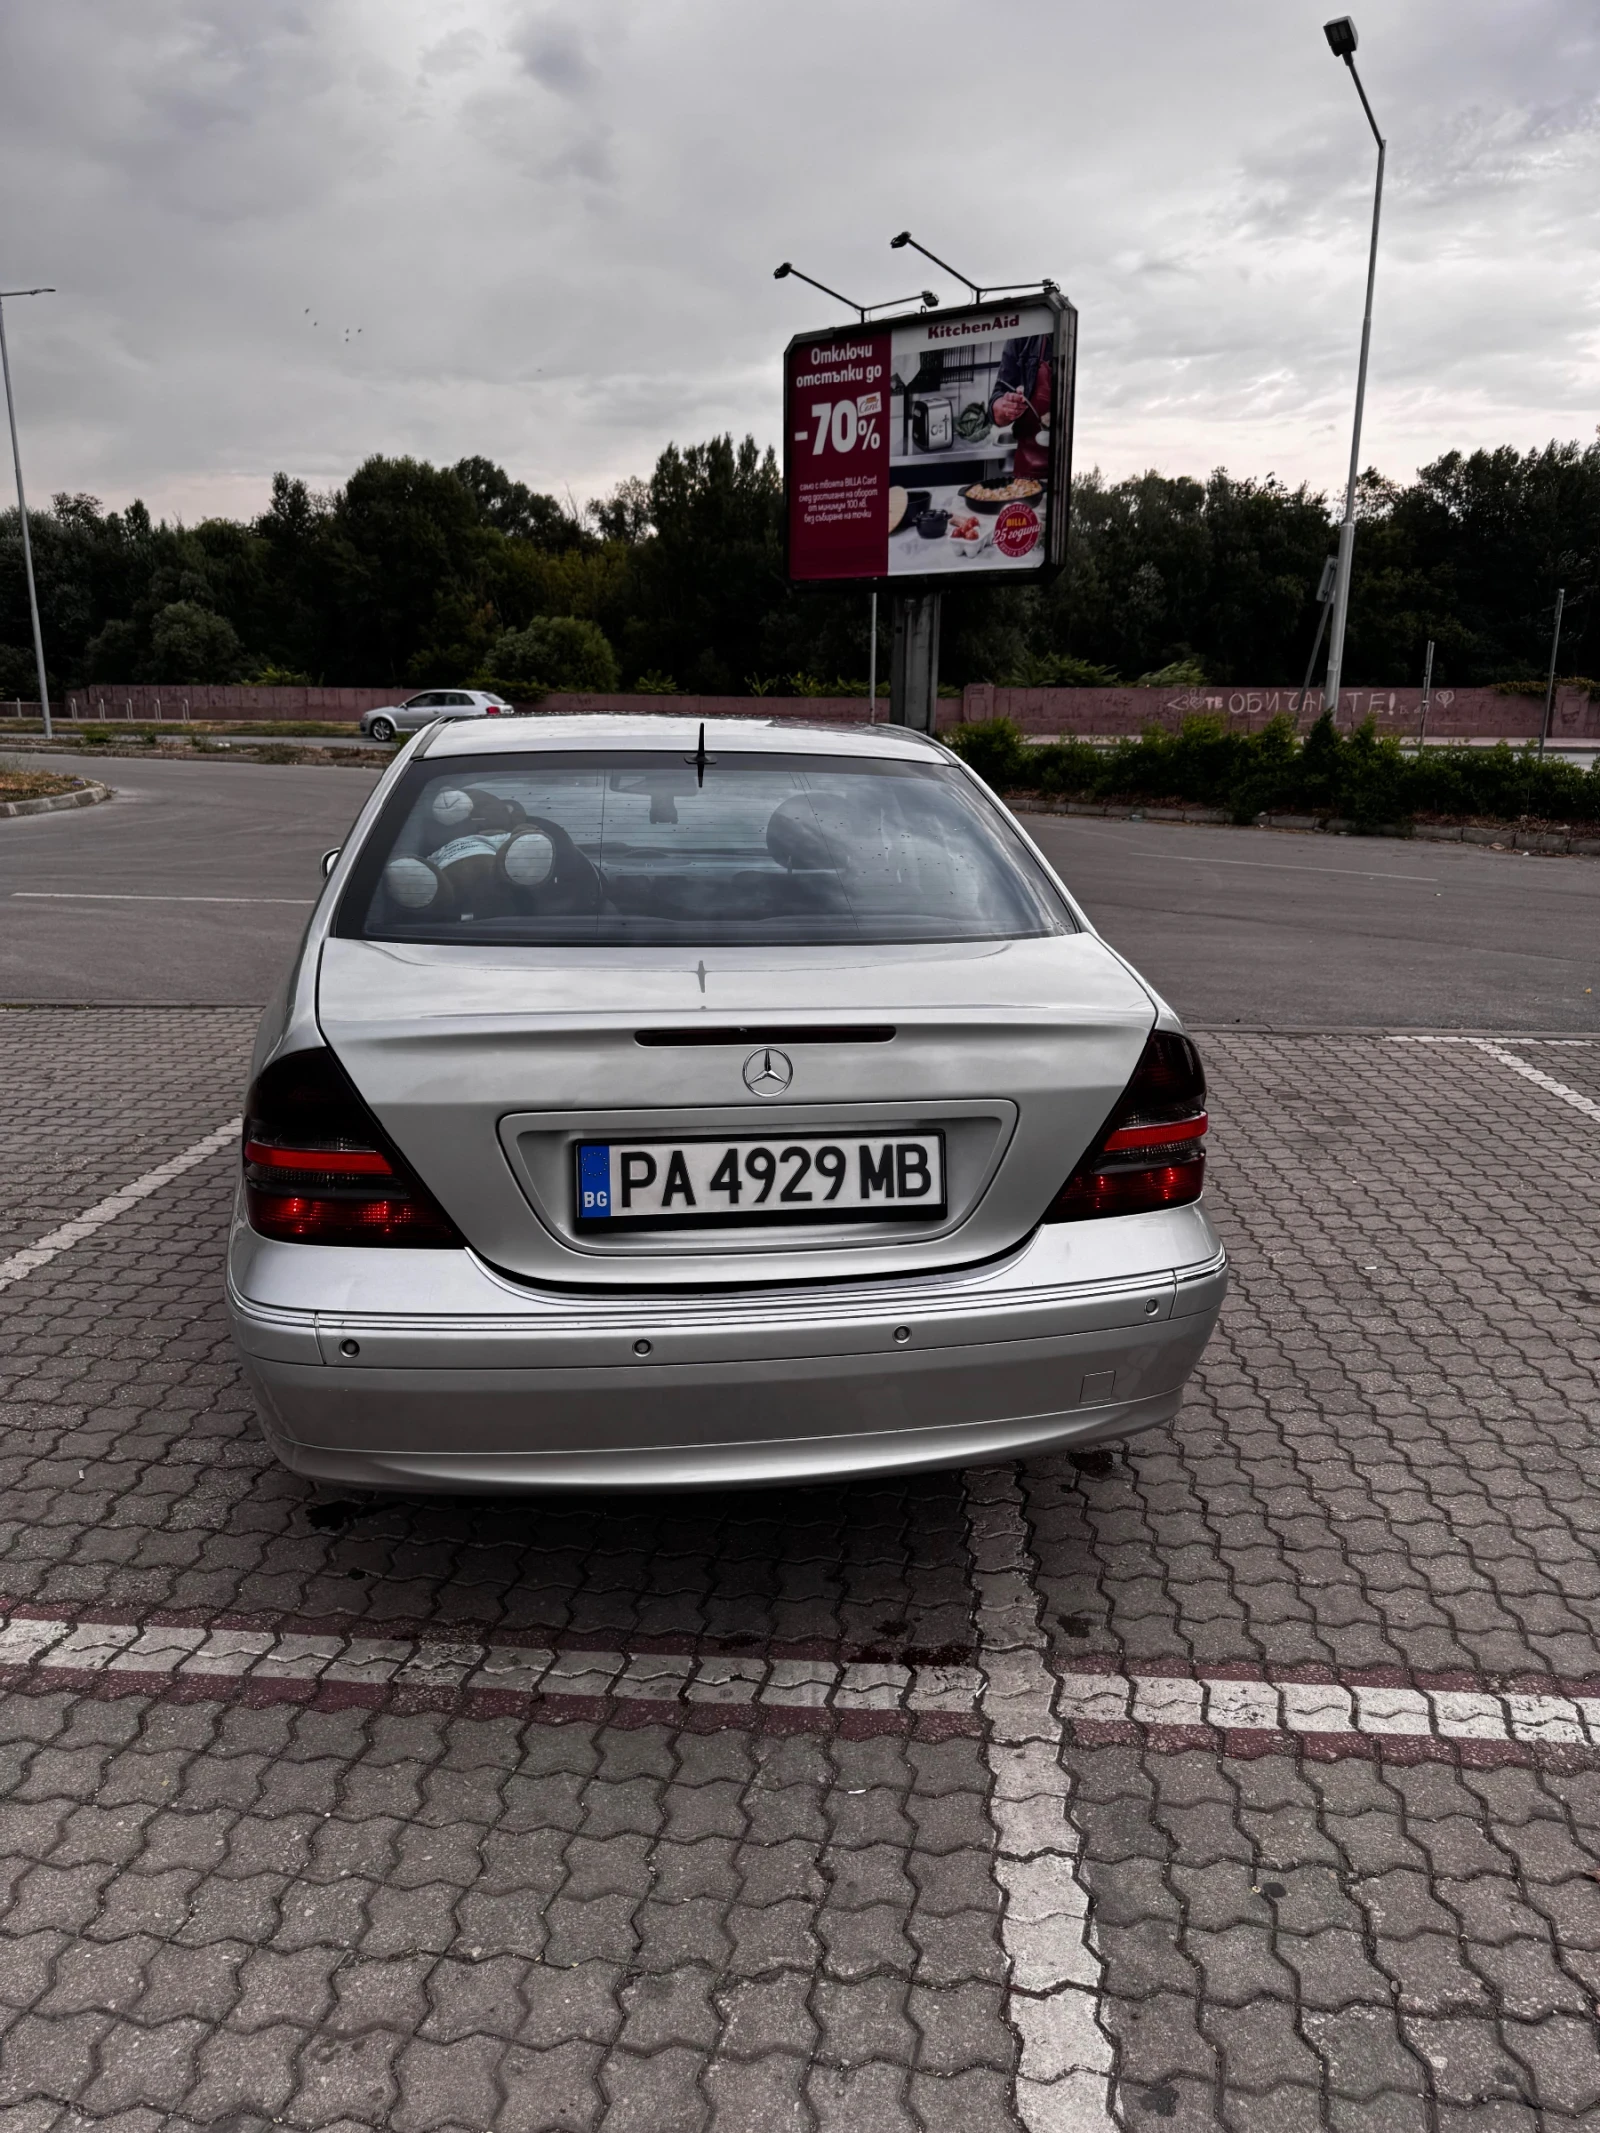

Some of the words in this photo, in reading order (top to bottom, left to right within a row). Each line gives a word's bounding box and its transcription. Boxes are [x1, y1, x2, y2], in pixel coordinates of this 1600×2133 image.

[928, 314, 1020, 339] KitchenAid
[811, 343, 873, 365] Отключи
[796, 364, 864, 388] отстъпки
[866, 365, 882, 383] до
[795, 400, 881, 455] -70%
[844, 476, 861, 487] BILLA
[862, 475, 877, 485] Card
[847, 499, 858, 508] 100
[1006, 517, 1027, 527] BILLA
[992, 528, 1008, 544] 25
[1008, 523, 1042, 542] години
[621, 1151, 696, 1208] PA
[710, 1146, 847, 1204] 4929
[859, 1143, 932, 1199] MB
[584, 1191, 607, 1208] BG
